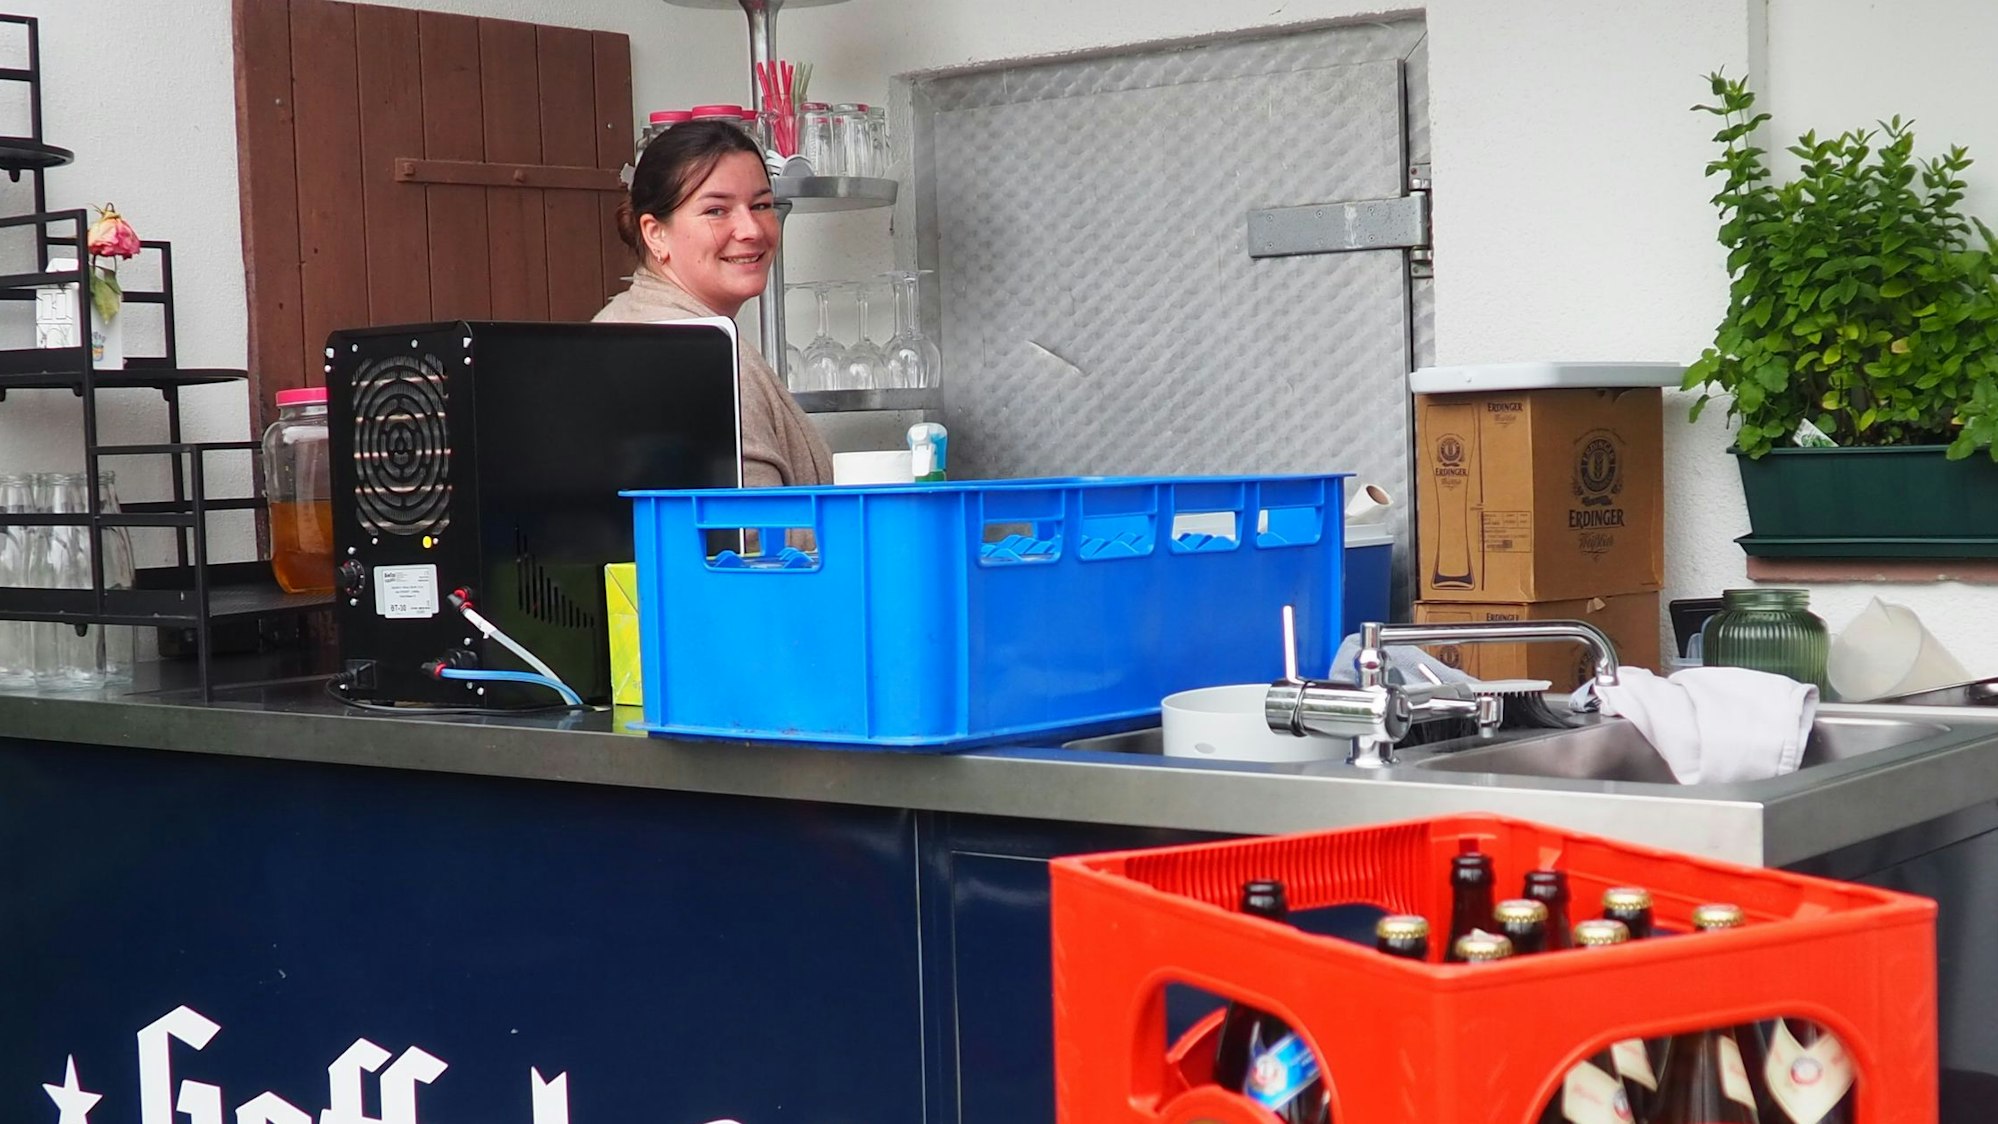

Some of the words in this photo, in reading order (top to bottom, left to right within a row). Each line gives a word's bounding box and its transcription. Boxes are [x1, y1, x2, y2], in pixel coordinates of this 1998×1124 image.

[1487, 402, 1523, 412] ERDINGER
[1435, 467, 1468, 477] ERDINGER
[1568, 508, 1625, 529] ERDINGER
